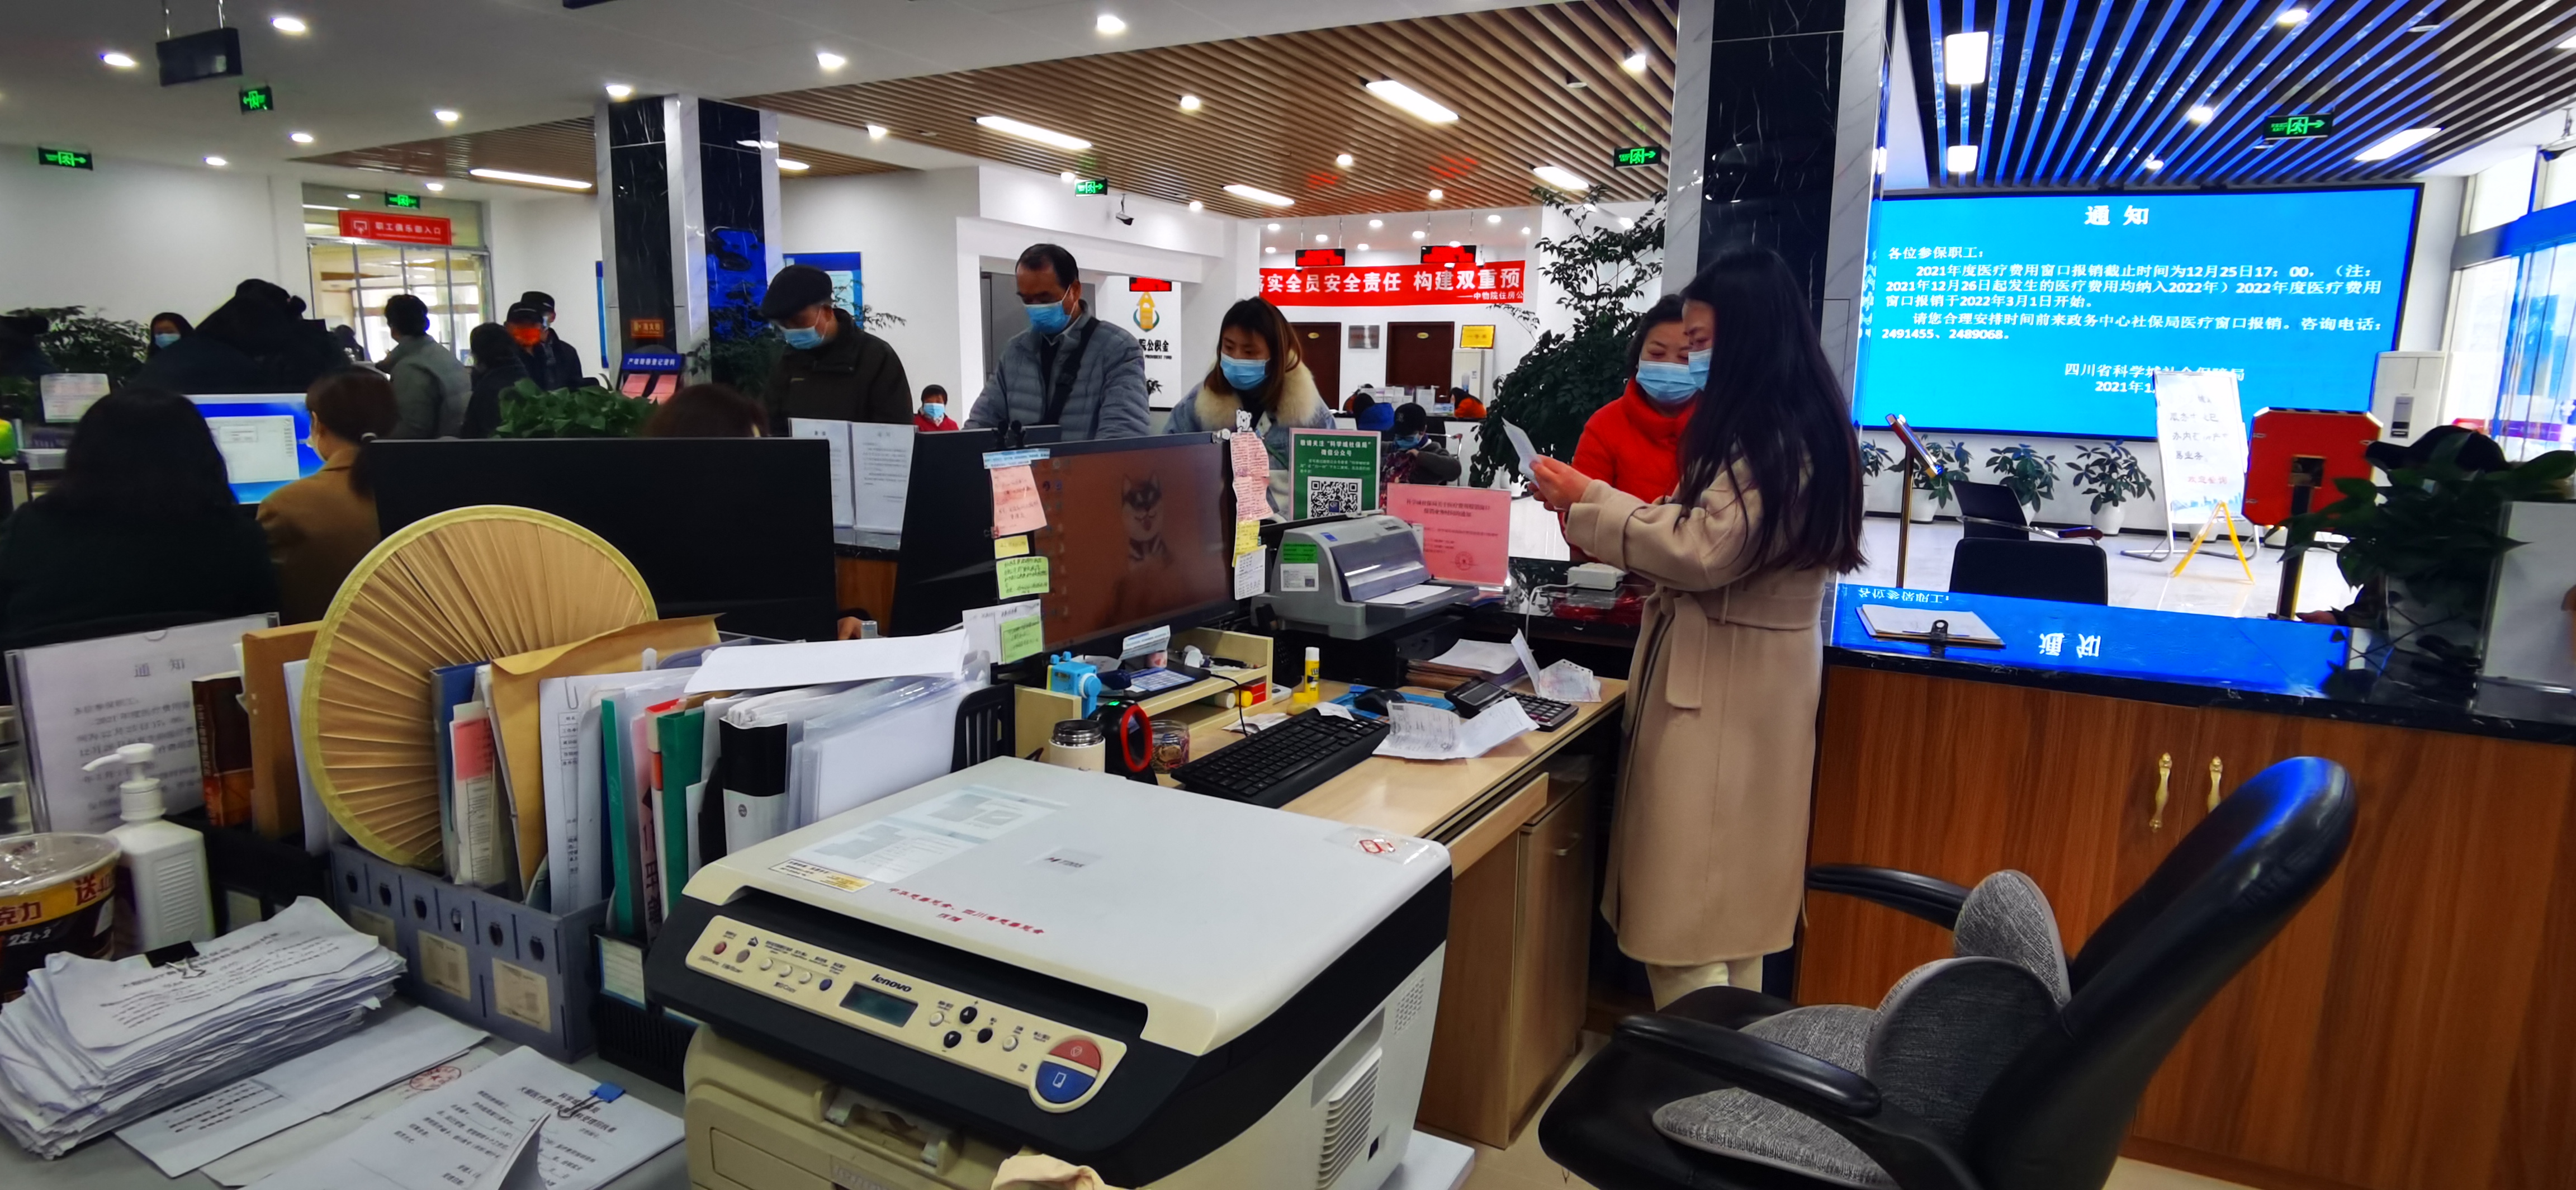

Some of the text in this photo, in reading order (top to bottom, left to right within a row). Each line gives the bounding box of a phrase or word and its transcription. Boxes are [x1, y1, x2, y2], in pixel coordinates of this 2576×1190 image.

[2084, 205, 2149, 226] 通知
[1888, 247, 1983, 259] 各位参保职工：
[1414, 268, 1521, 291] 构建双重预
[2065, 363, 2245, 381] 四川省科学城局
[2095, 381, 2156, 393] 2021年1
[871, 974, 912, 993] lenovo
